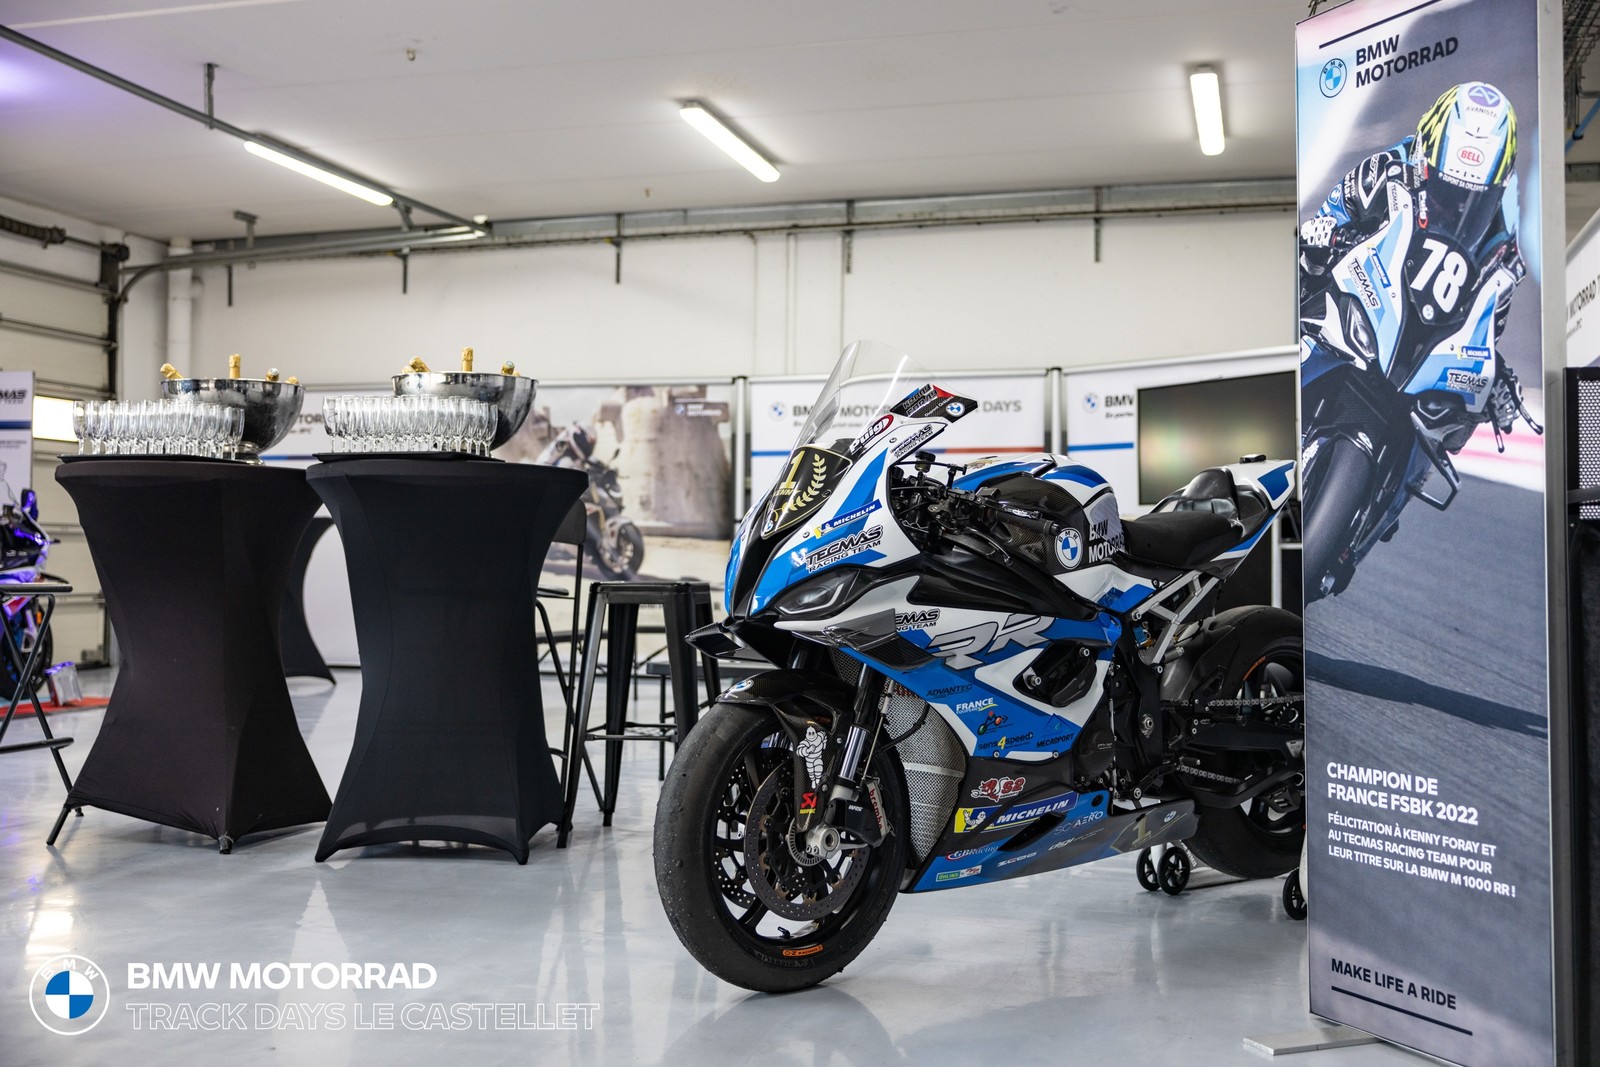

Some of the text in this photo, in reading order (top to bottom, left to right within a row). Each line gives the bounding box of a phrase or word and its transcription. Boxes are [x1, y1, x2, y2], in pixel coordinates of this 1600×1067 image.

[1356, 34, 1400, 66] BMW
[1356, 37, 1459, 88] MOTORRAD
[1460, 149, 1481, 163] BELL
[1351, 258, 1379, 307] TECMAS
[1410, 238, 1468, 313] 78
[1449, 372, 1488, 388] TECMAS
[982, 400, 1022, 412] DAYS
[779, 450, 805, 488] 1
[833, 504, 876, 528] MICHELIN
[1089, 519, 1109, 541] BMW
[806, 526, 883, 567] TECMAS
[808, 540, 881, 573] RACING TEAM
[912, 621, 937, 629] TEAM
[927, 683, 973, 696] ADVANTEC
[956, 697, 994, 711] FRANCE
[1327, 762, 1438, 795] CHAMPION DE
[868, 788, 884, 830] brembo
[996, 800, 1069, 824] MICHELIN
[1328, 783, 1478, 825] FRANCE FSBK 2022
[1131, 816, 1152, 847] 1
[1328, 811, 1497, 857] FÉLICITATION À KENNY FORAY ET
[1328, 829, 1492, 875] AU TECMAS RACING TEAM POUR
[1328, 845, 1516, 898] LEUR TITRE SUR LA BMW M 1000 RR !
[1331, 958, 1457, 1010] MAKE LIFE A RIDE
